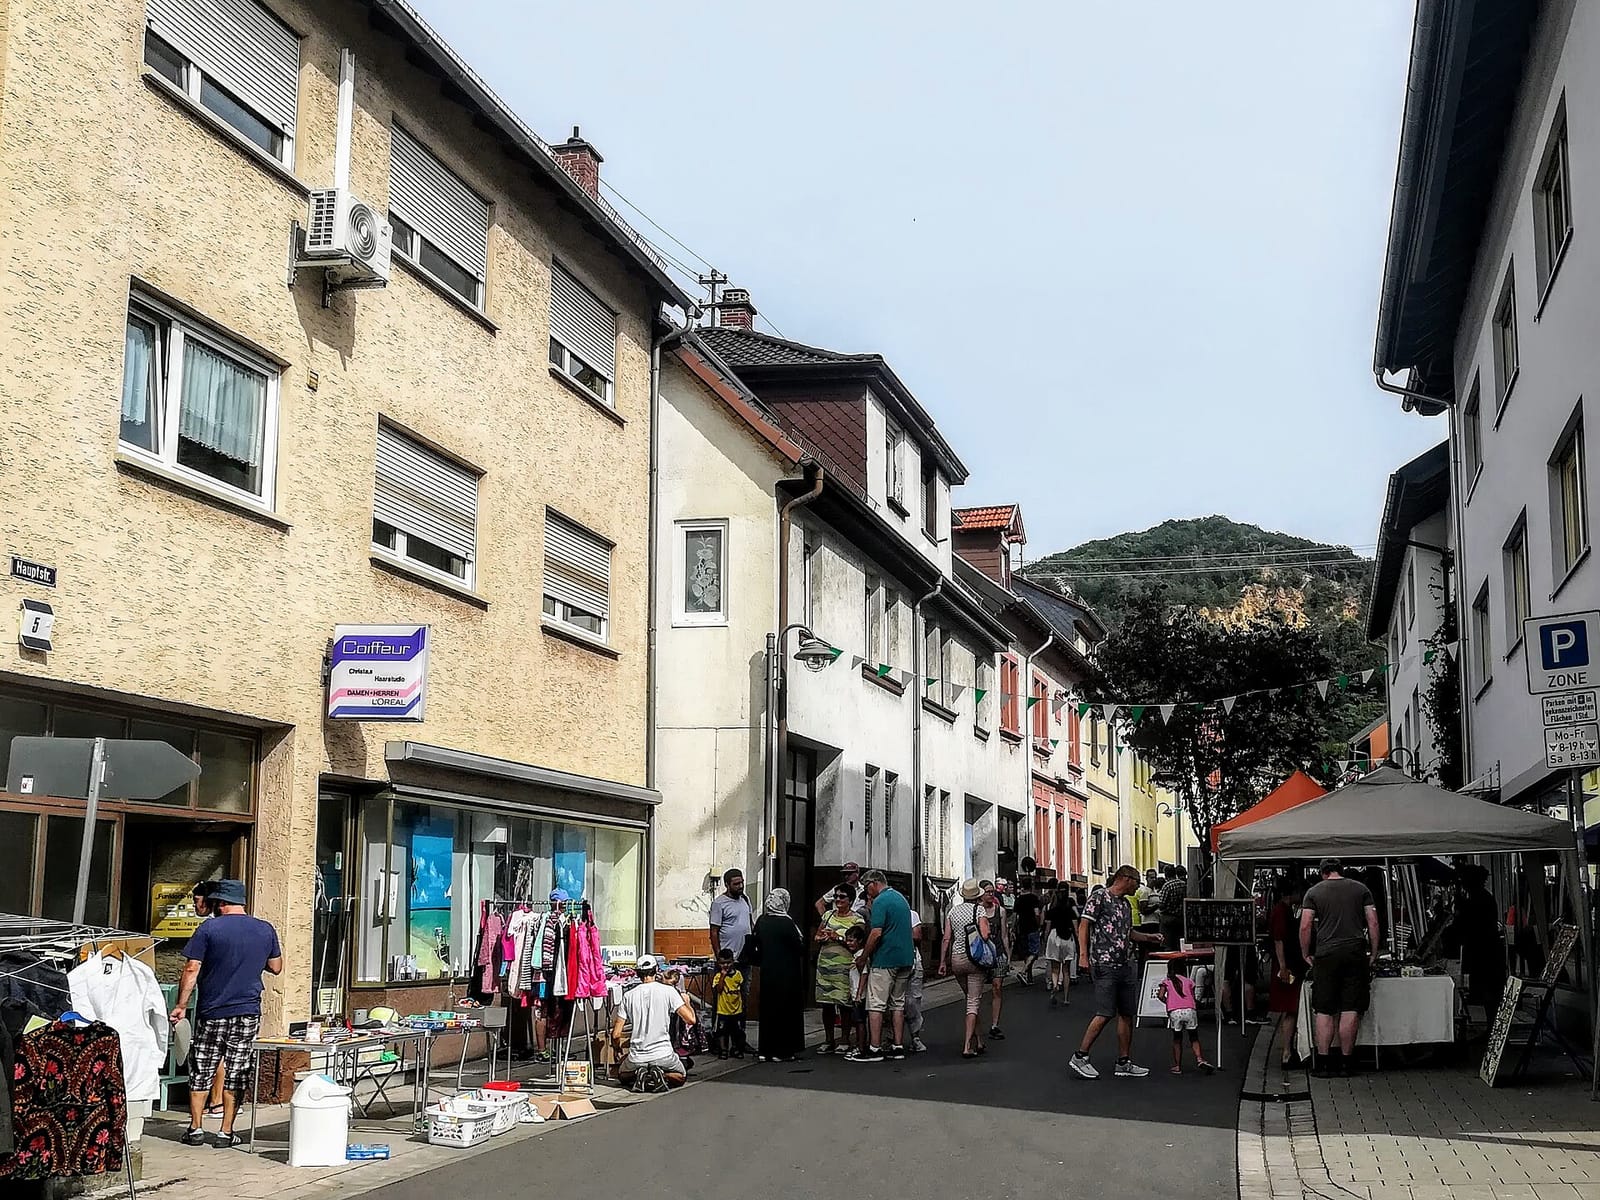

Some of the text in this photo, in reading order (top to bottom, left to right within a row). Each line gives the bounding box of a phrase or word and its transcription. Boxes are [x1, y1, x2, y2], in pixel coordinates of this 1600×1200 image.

[16, 560, 52, 582] Hauptstr.
[31, 617, 40, 633] 5
[342, 640, 411, 655] Coiffeur
[1551, 628, 1576, 663] P
[374, 675, 406, 683] Haarstudio
[1548, 672, 1588, 688] ZONE
[1545, 699, 1565, 708] Parken
[1567, 696, 1577, 705] mit
[1555, 729, 1585, 741] Mo-Fr
[1559, 740, 1585, 752] 8-19 h
[1550, 750, 1597, 764] Sa 8-13 h
